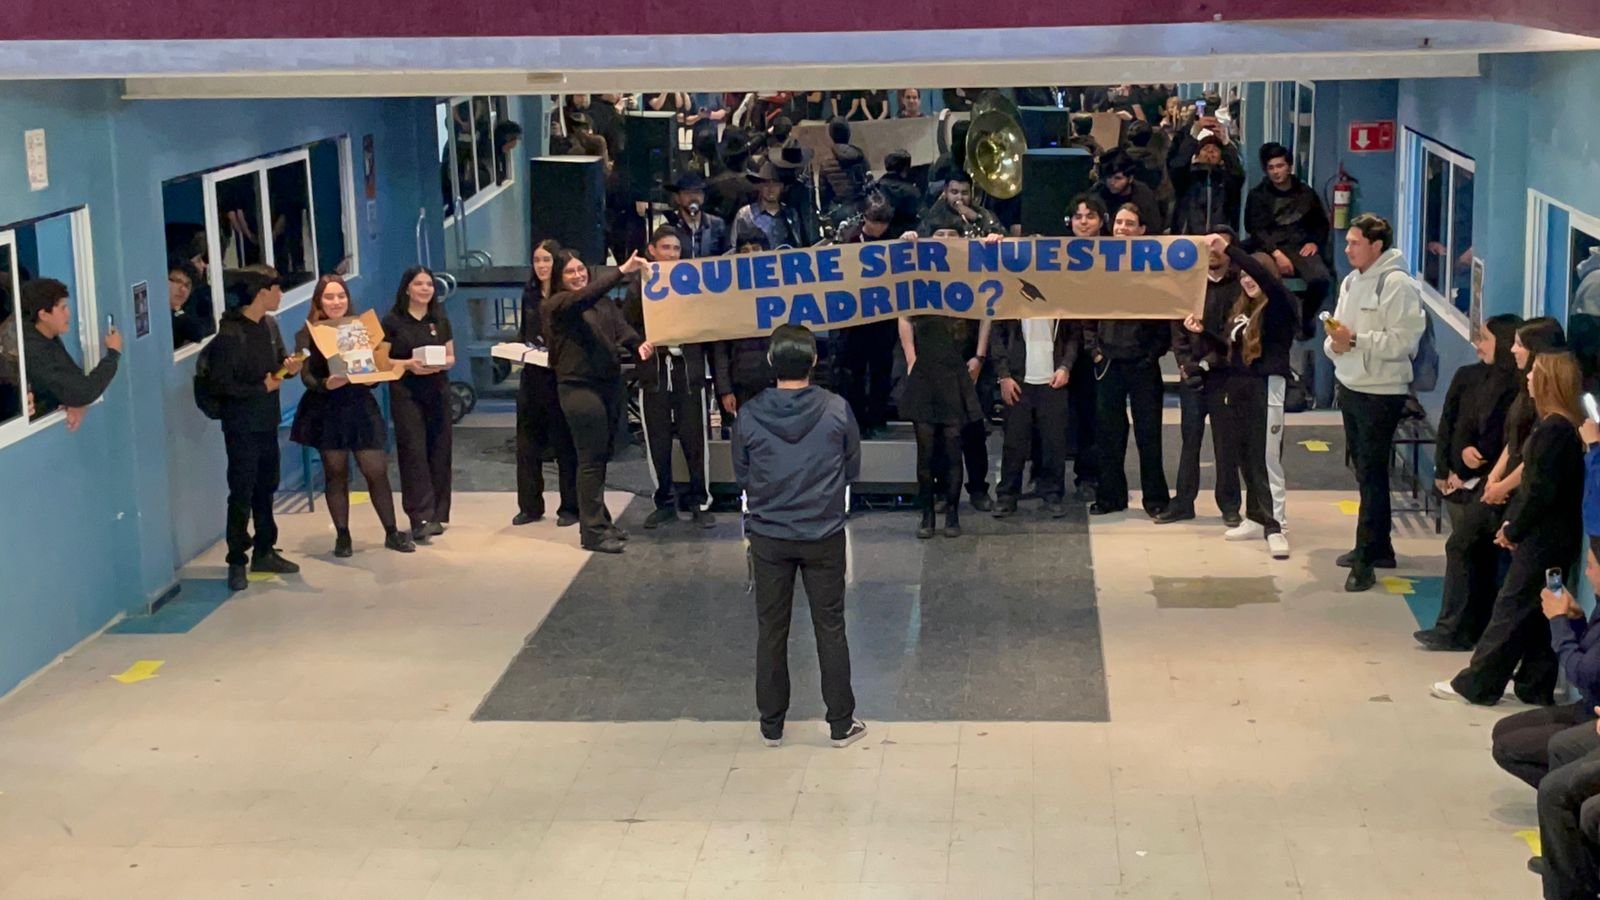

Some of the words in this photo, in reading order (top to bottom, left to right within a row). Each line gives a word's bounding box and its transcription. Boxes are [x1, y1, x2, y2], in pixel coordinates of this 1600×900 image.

[644, 248, 844, 301] ¿QUIERE
[859, 241, 950, 278] SER
[968, 239, 1198, 273] NUESTRO
[756, 279, 1004, 330] PADRINO?
